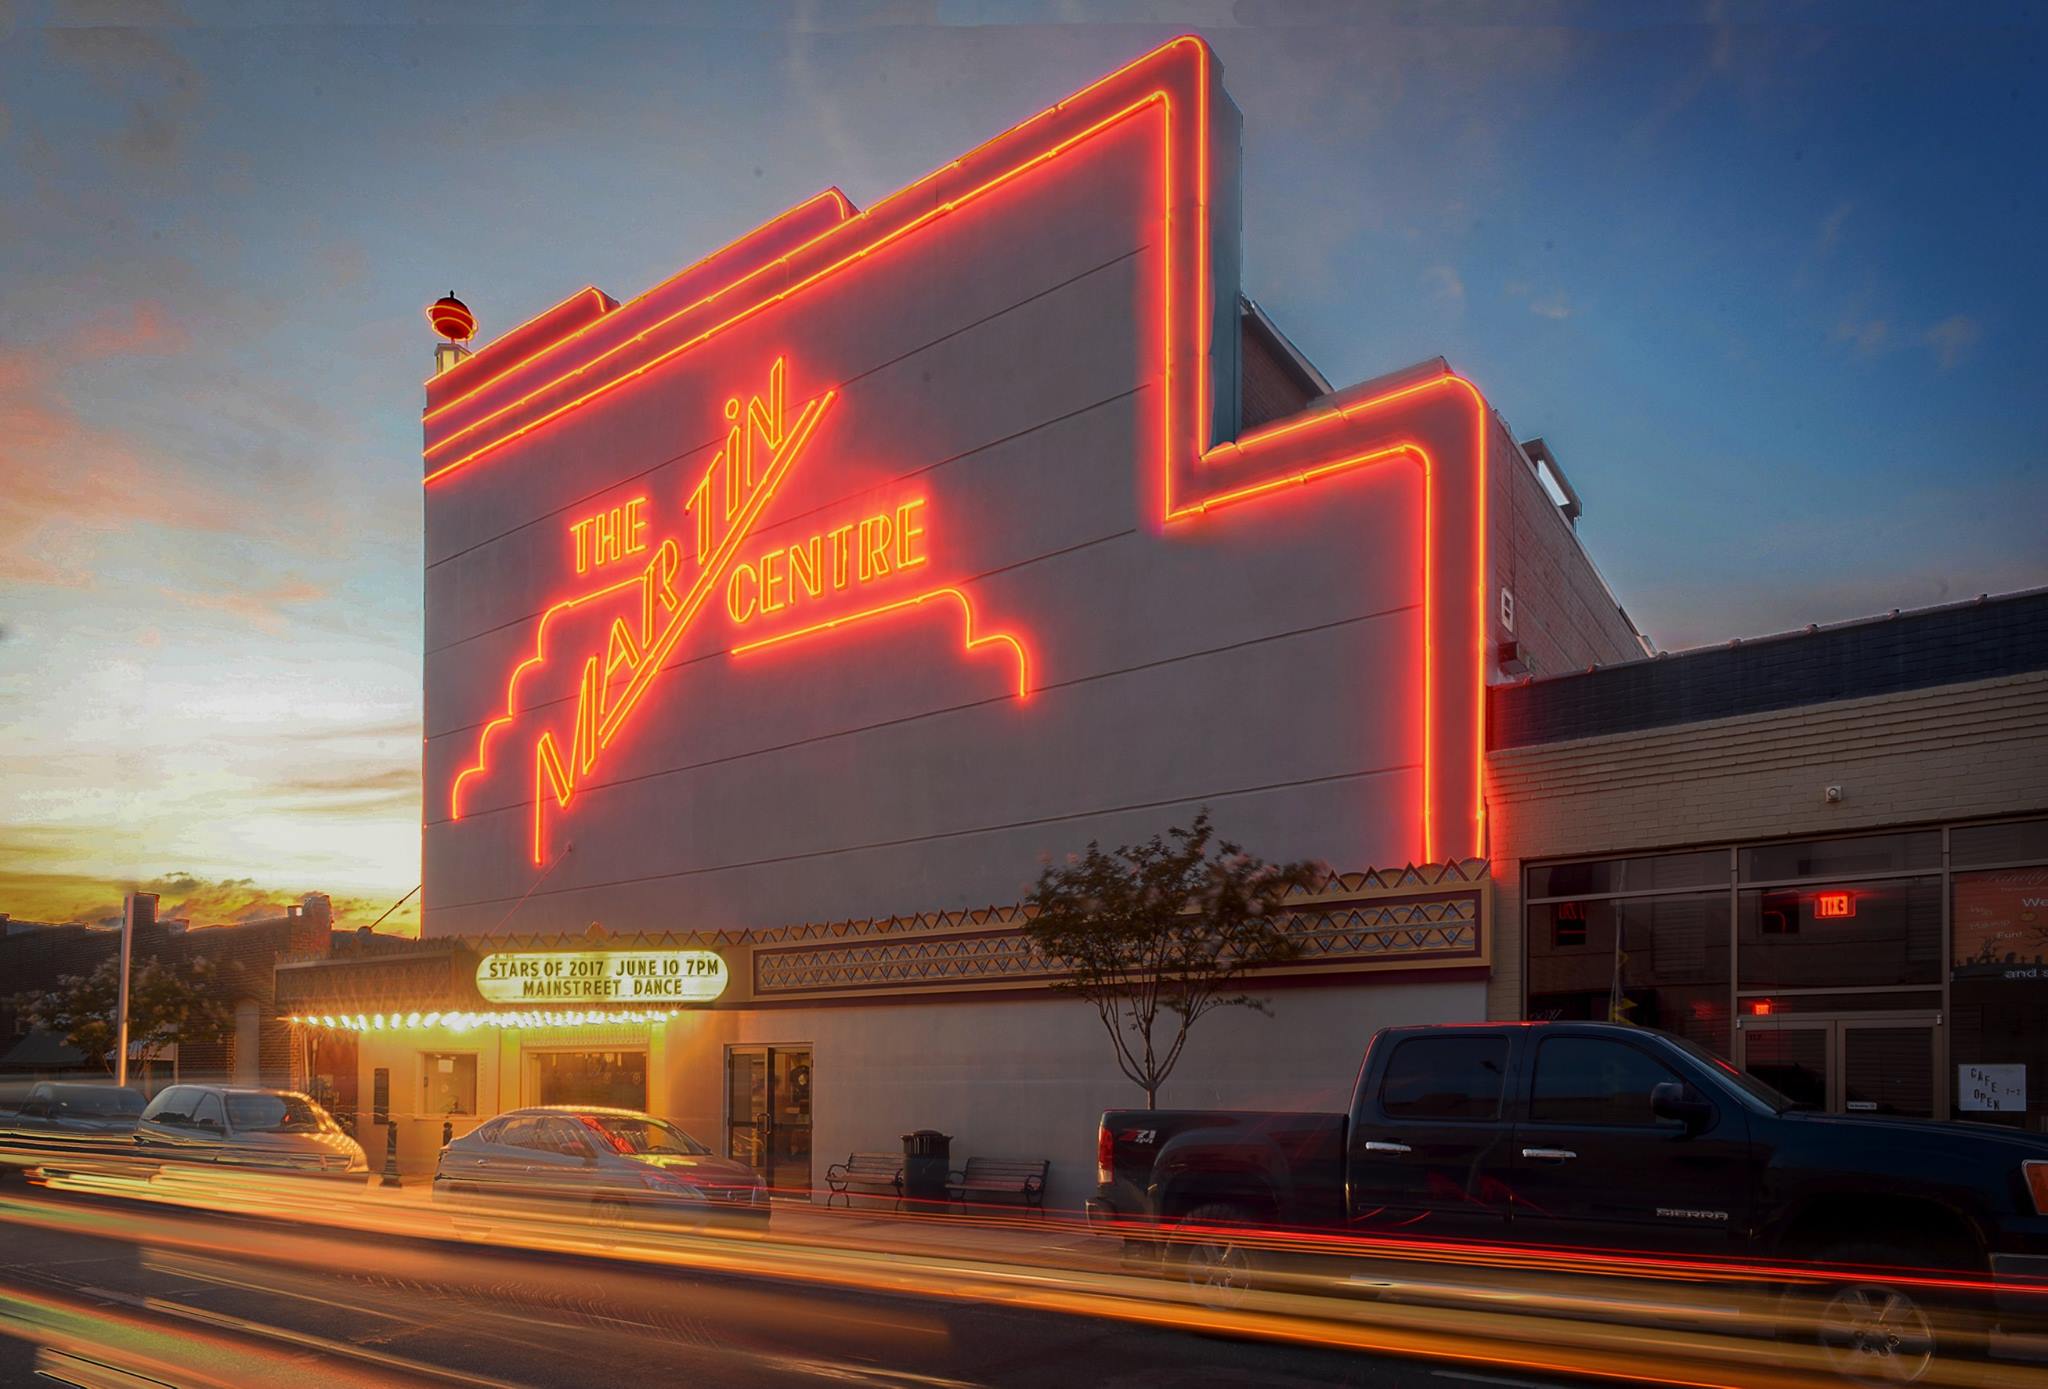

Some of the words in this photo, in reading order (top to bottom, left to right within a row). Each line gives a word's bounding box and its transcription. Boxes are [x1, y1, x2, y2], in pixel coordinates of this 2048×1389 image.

[570, 497, 648, 574] THE
[726, 500, 927, 623] CENTRE
[489, 961, 539, 978] STARS
[544, 961, 564, 977] OF
[569, 960, 604, 977] 2017
[615, 960, 657, 976] JUNE
[663, 959, 680, 976] 10
[687, 959, 719, 976] 7PM
[2004, 967, 2037, 979] and
[523, 978, 621, 996] MAINSTREET
[633, 978, 683, 996] DANCE
[1970, 1067, 1999, 1093] CAFE
[1974, 1089, 2000, 1110] OPEN
